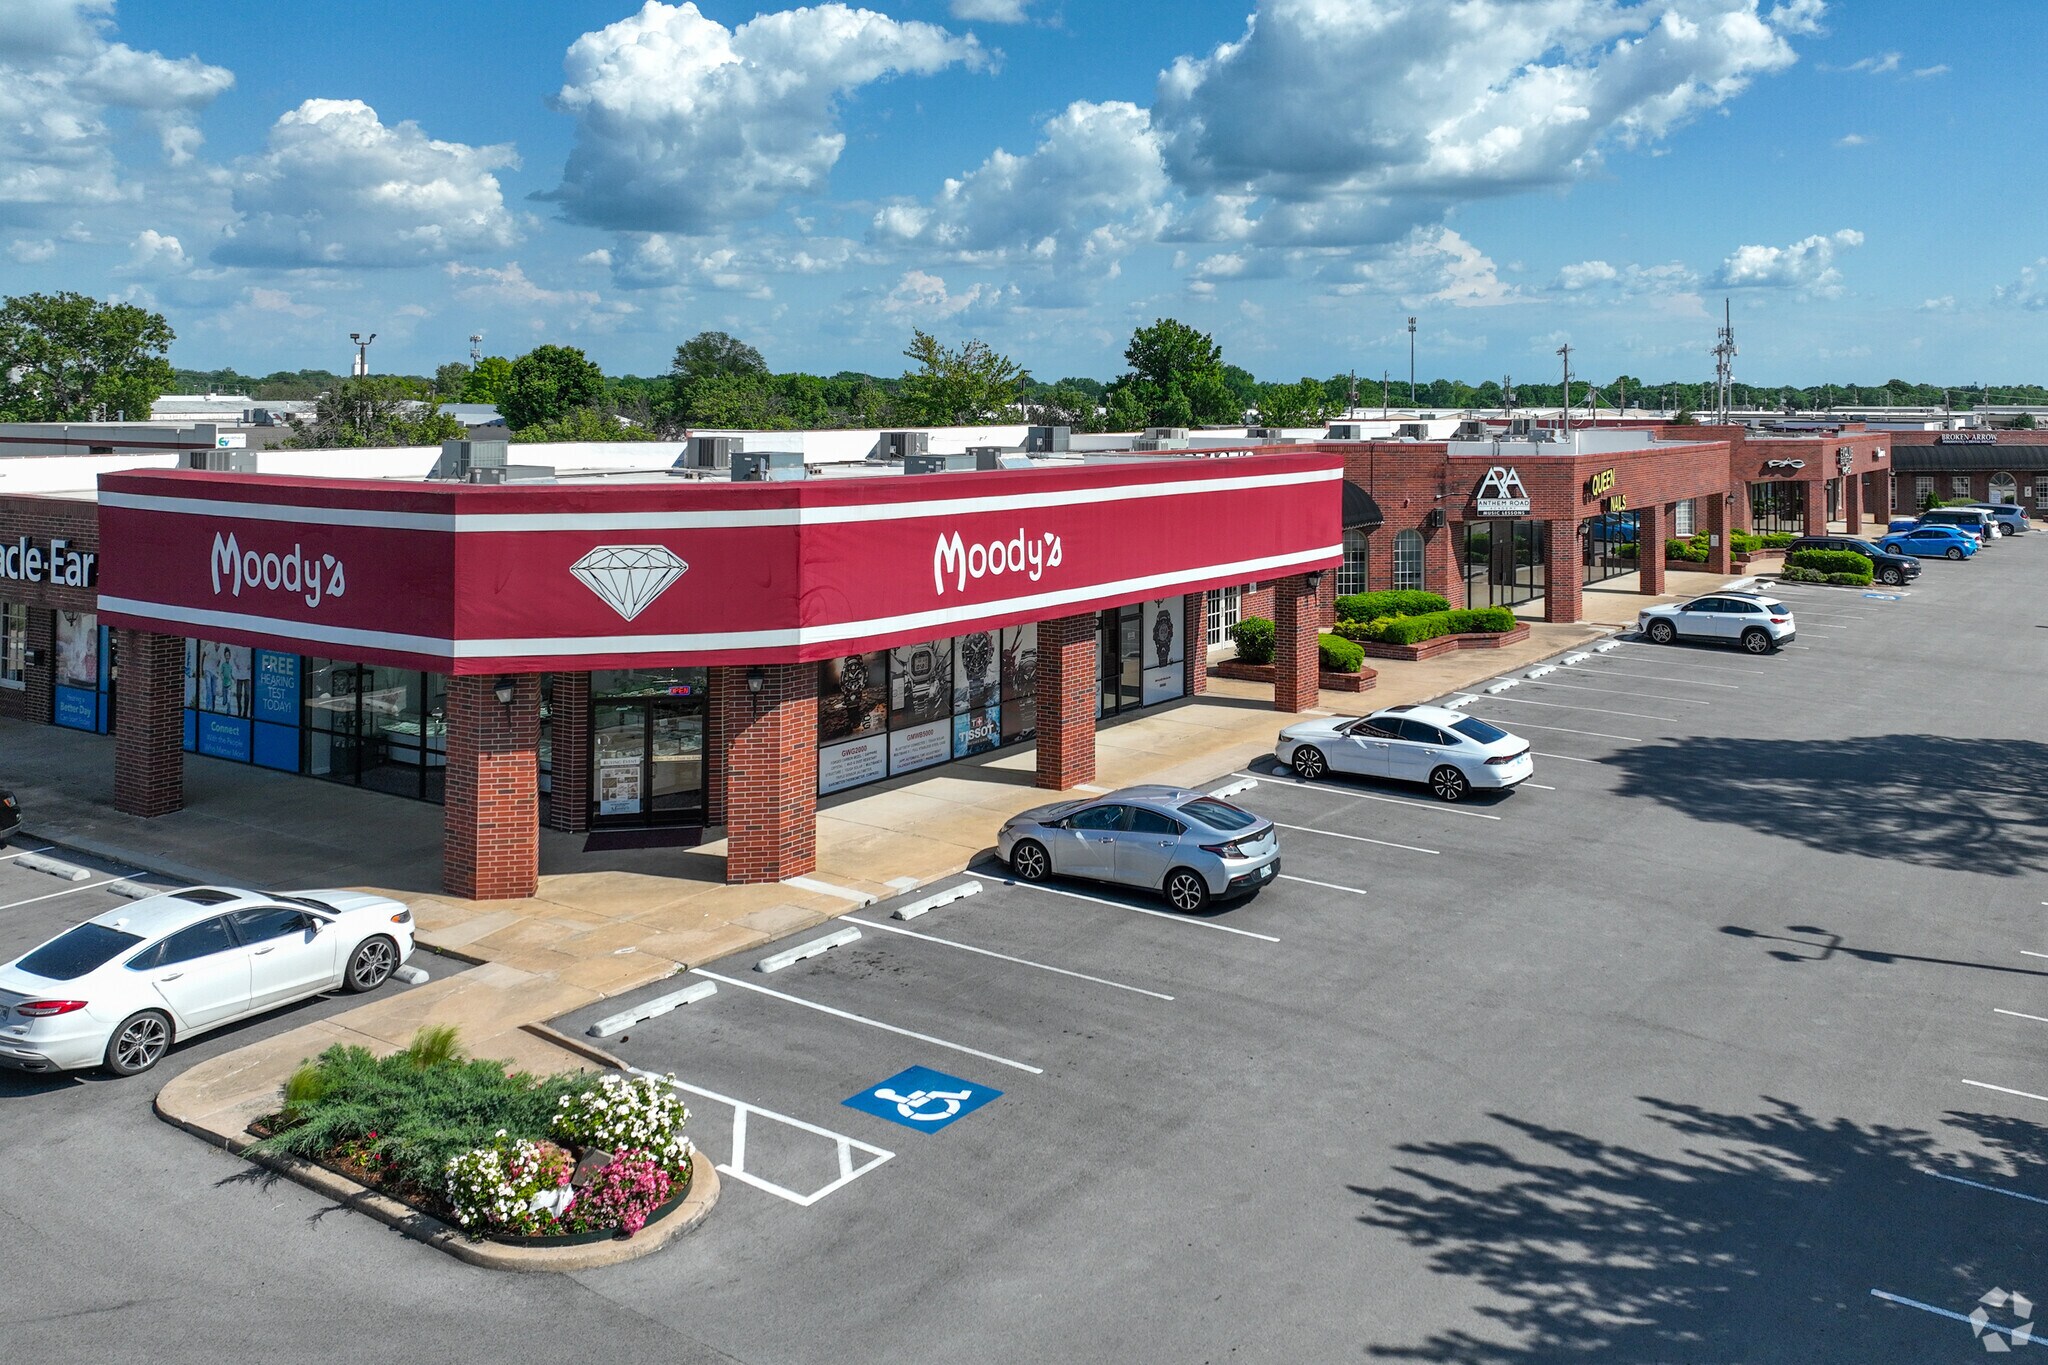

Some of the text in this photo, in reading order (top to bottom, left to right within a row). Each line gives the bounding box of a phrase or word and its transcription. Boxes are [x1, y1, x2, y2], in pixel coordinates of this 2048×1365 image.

[211, 531, 345, 608] Moody's
[934, 528, 1062, 595] Moody's
[262, 655, 294, 675] FREE
[261, 672, 294, 688] HEARING
[268, 686, 285, 699] TEST
[263, 698, 291, 712] TODAY!
[211, 721, 239, 735] Connect
[959, 724, 994, 741] TISSOT
[841, 745, 867, 757] GWG2000
